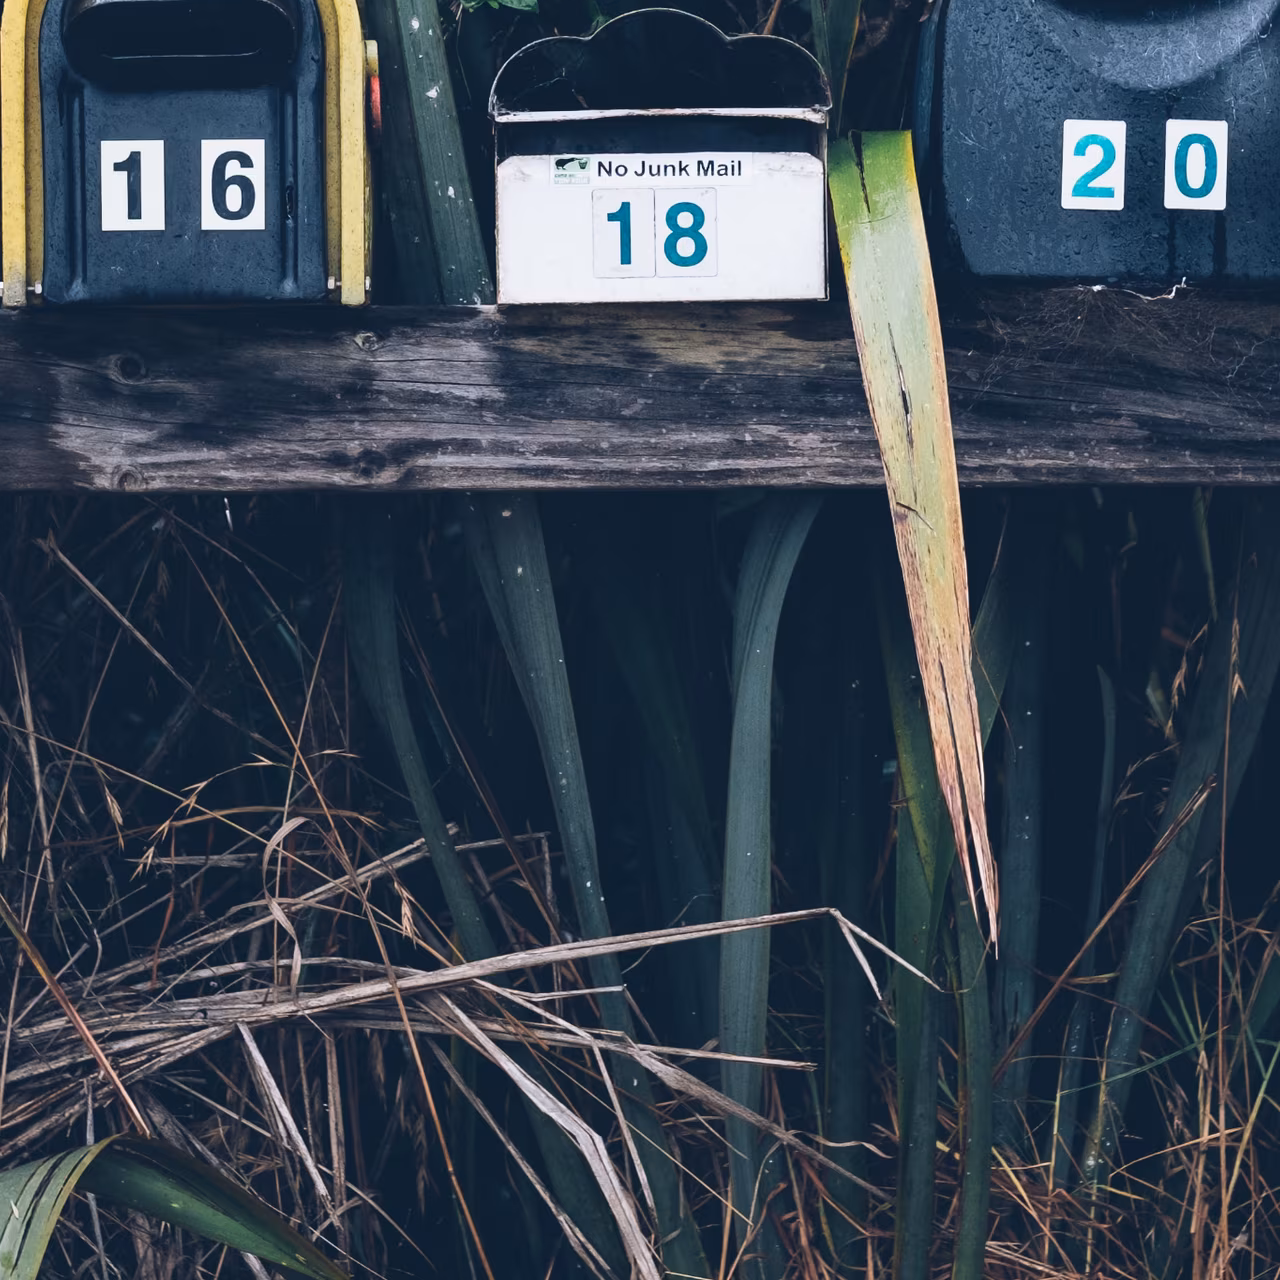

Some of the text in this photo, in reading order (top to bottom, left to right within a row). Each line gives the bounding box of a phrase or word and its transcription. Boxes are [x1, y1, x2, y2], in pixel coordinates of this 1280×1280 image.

[597, 159, 742, 177] No Junk Mail
[606, 201, 709, 268] 18
